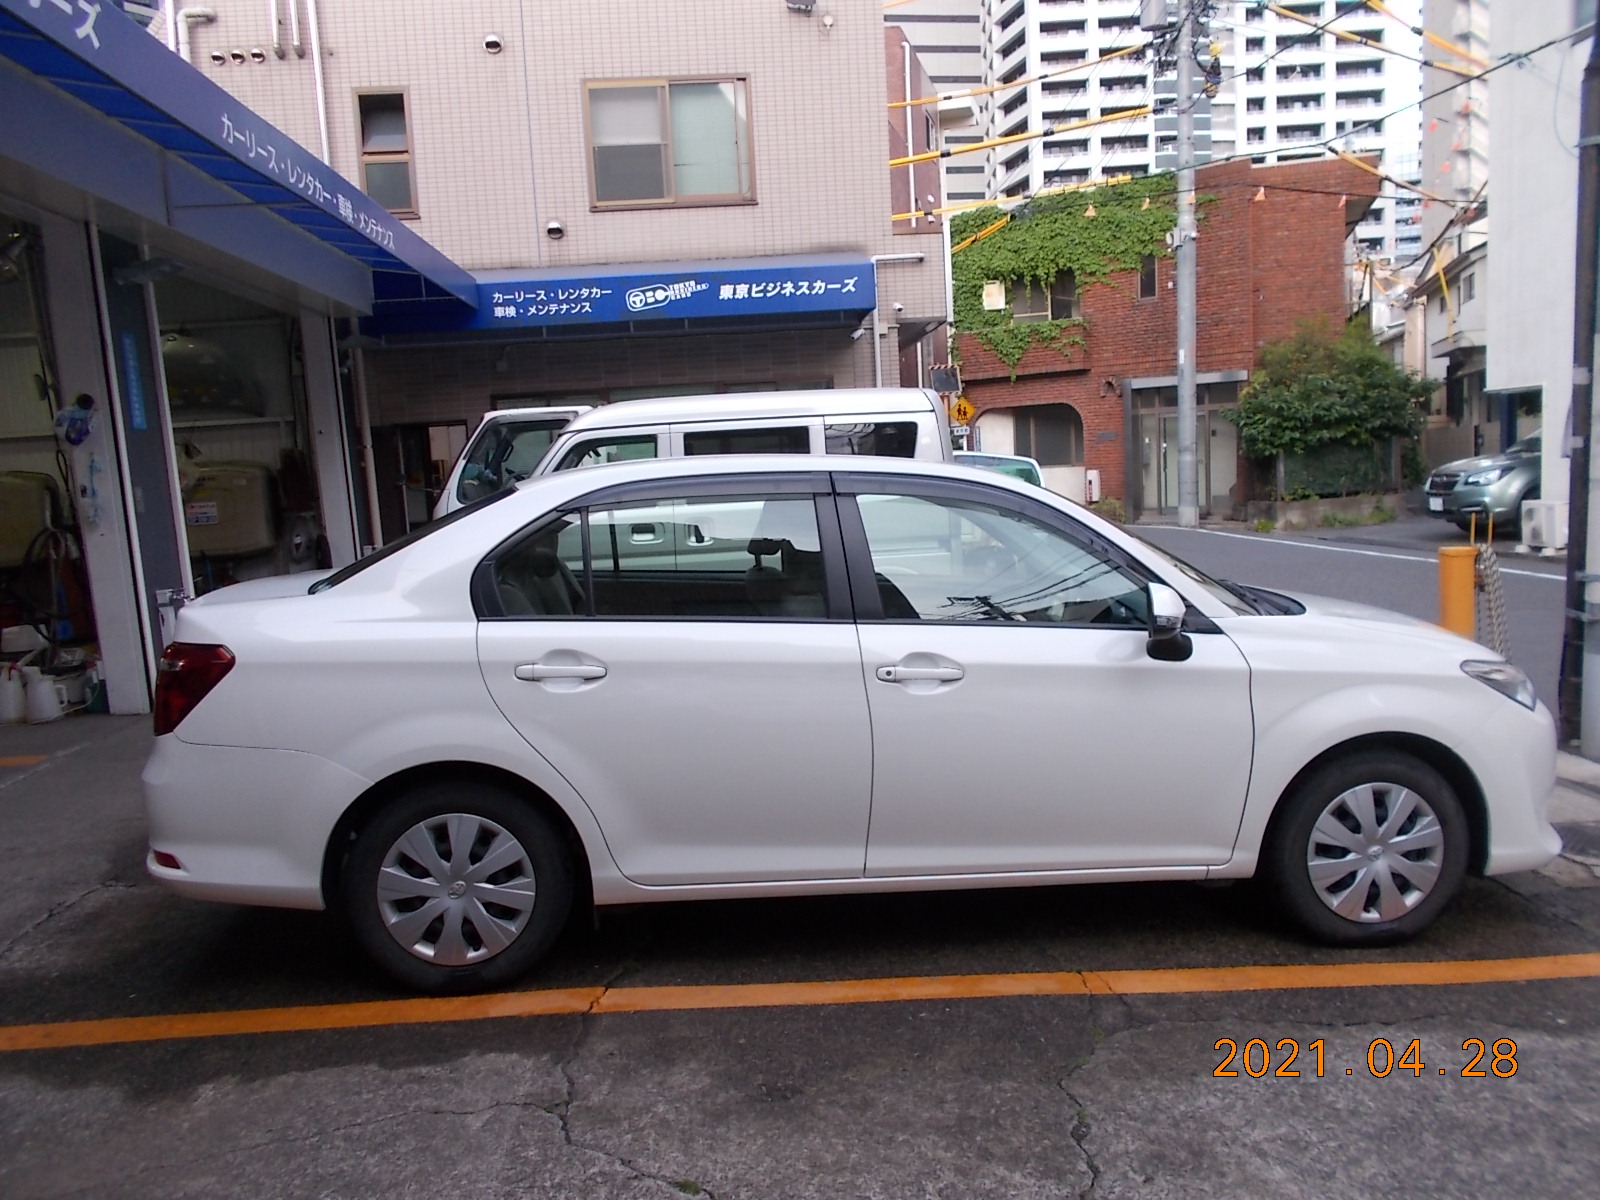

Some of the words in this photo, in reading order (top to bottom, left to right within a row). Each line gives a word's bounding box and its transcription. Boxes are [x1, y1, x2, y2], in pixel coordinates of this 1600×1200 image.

[492, 287, 613, 303] カーリース・レンタカー
[719, 276, 859, 300] 東京ビジネスカーズ
[493, 302, 592, 318] 車検・メンテナンス
